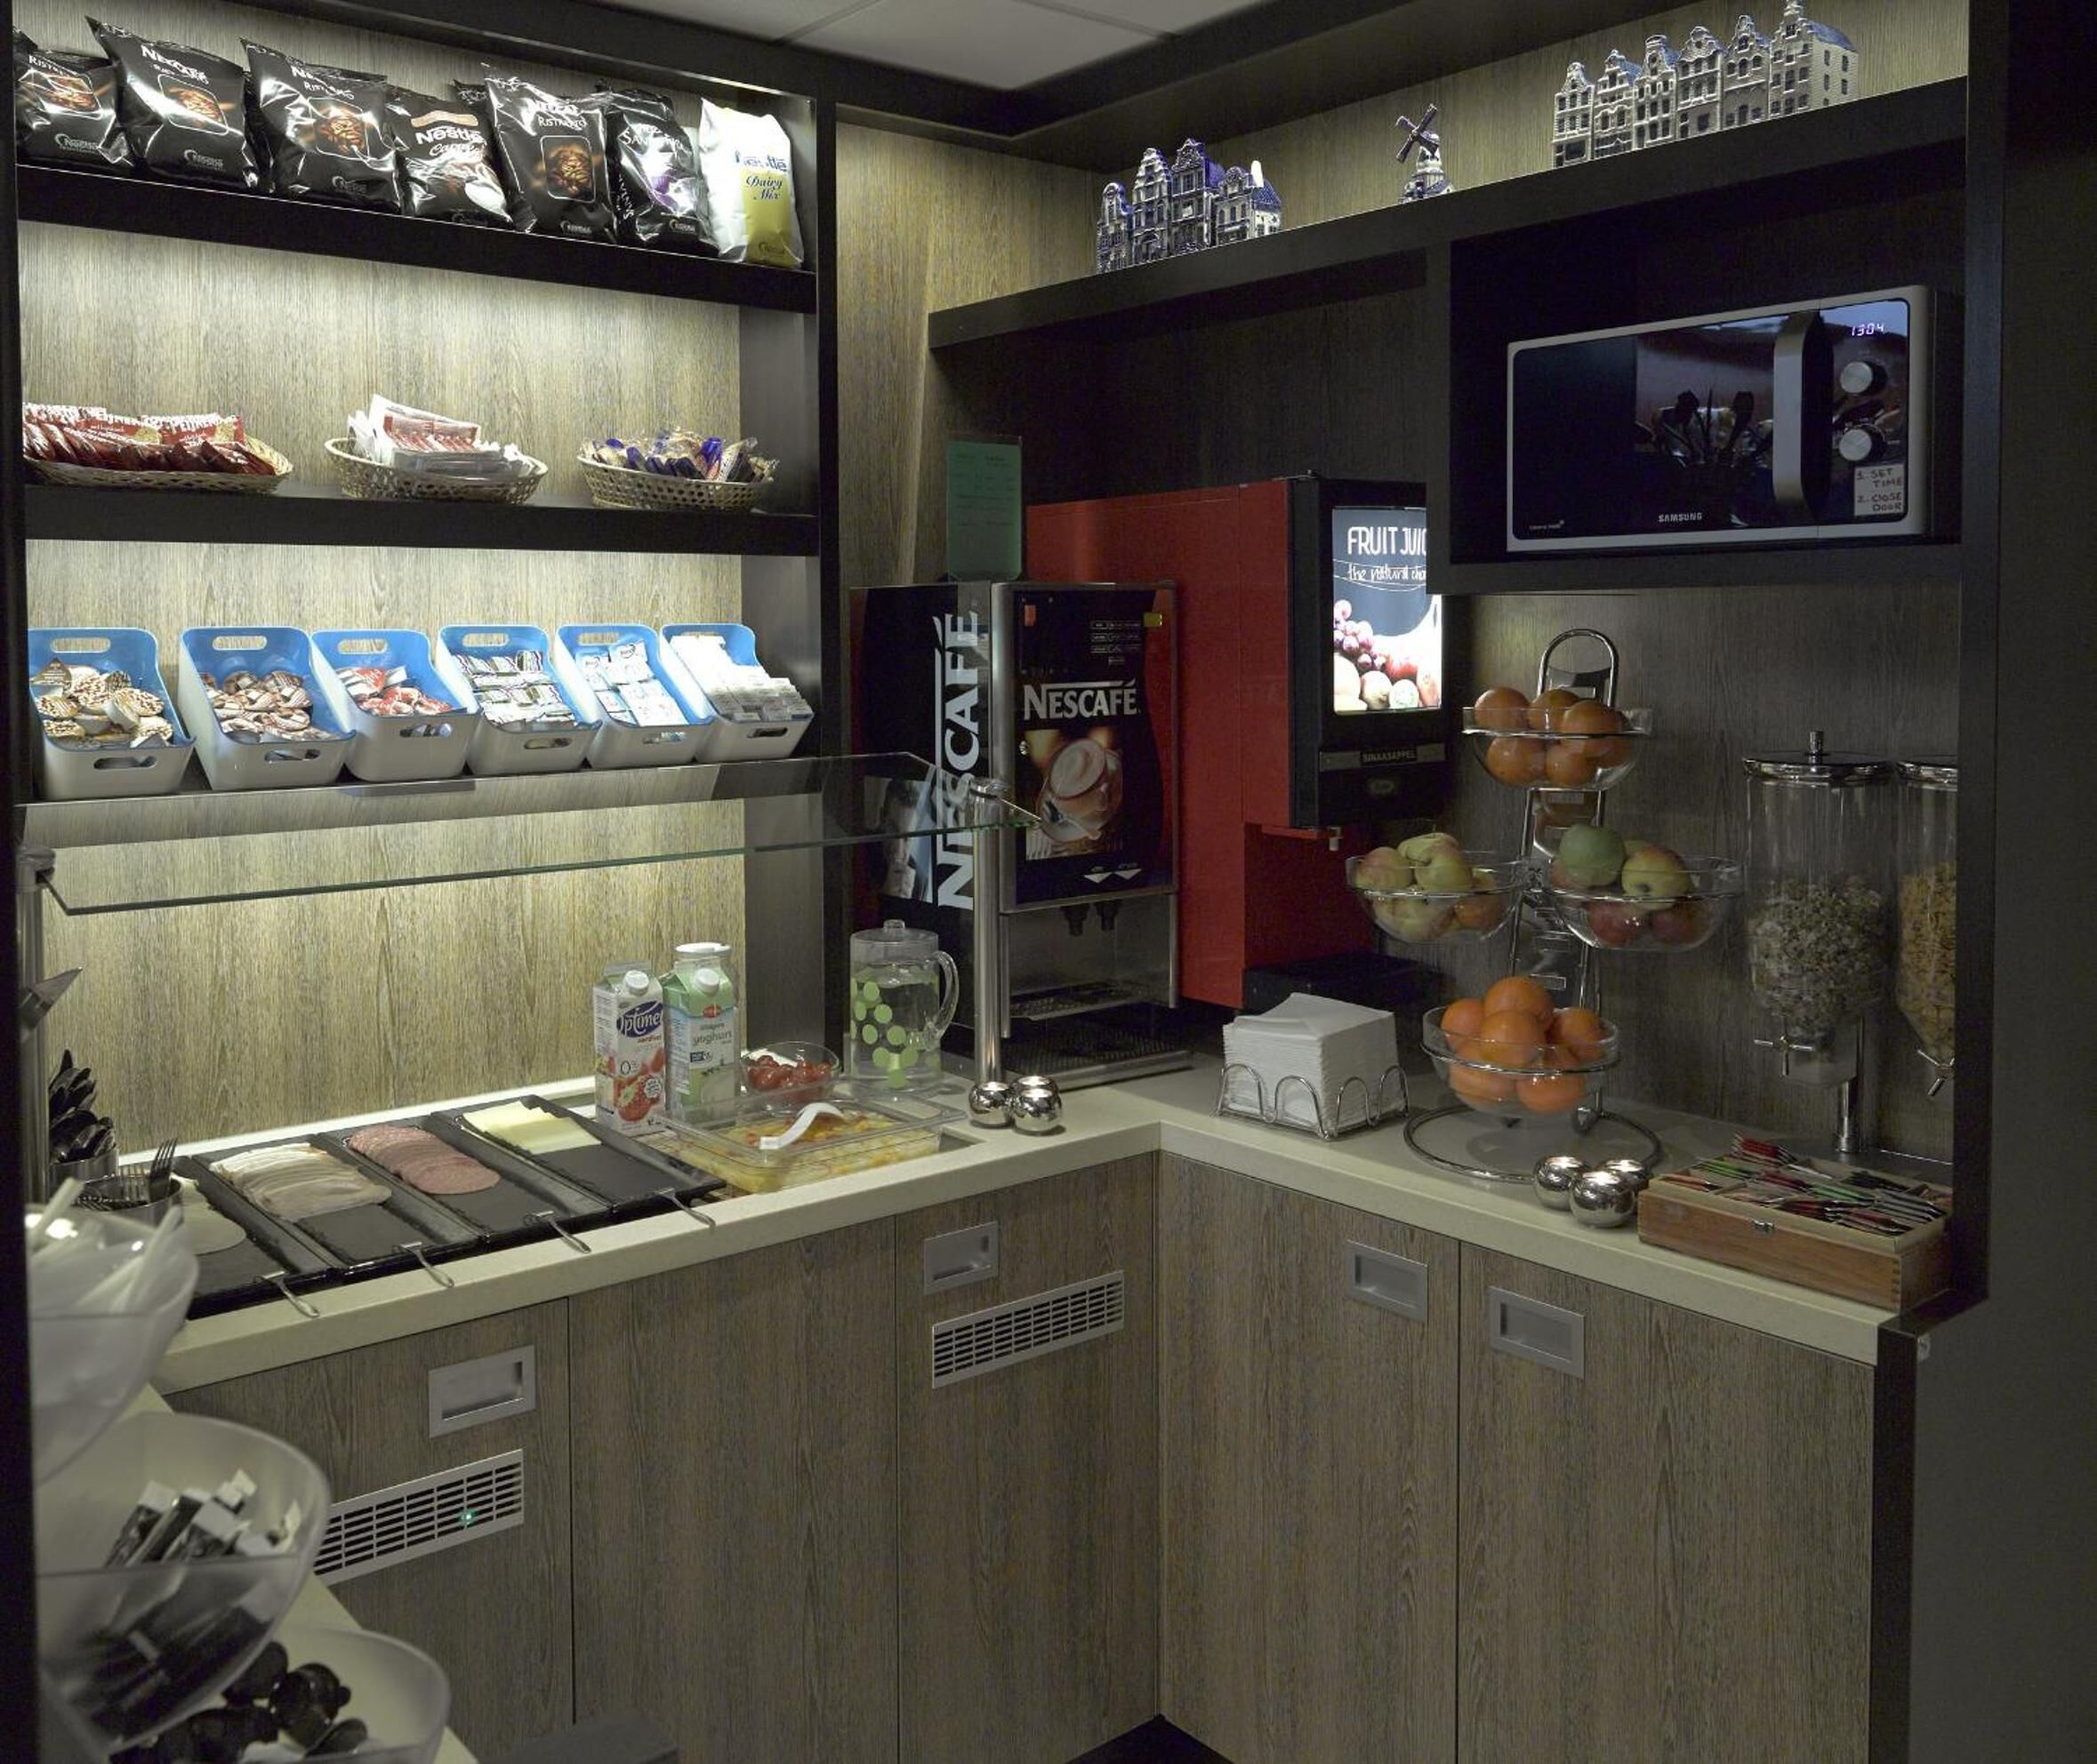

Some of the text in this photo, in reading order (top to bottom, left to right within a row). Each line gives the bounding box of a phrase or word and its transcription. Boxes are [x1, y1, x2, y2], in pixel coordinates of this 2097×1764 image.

[745, 175, 783, 190] Dairy
[752, 188, 782, 200] Mix
[1870, 468, 1893, 479] SET
[1872, 477, 1902, 487] TIME
[1871, 492, 1902, 502] CLOSE
[1872, 502, 1902, 512] DOOR
[1659, 512, 1702, 523] SAMSUNG
[1347, 526, 1398, 555] FRUIT
[1348, 564, 1367, 581] the
[1024, 678, 1137, 721] NESCAFÉ
[933, 611, 979, 911] NESCAFÉ
